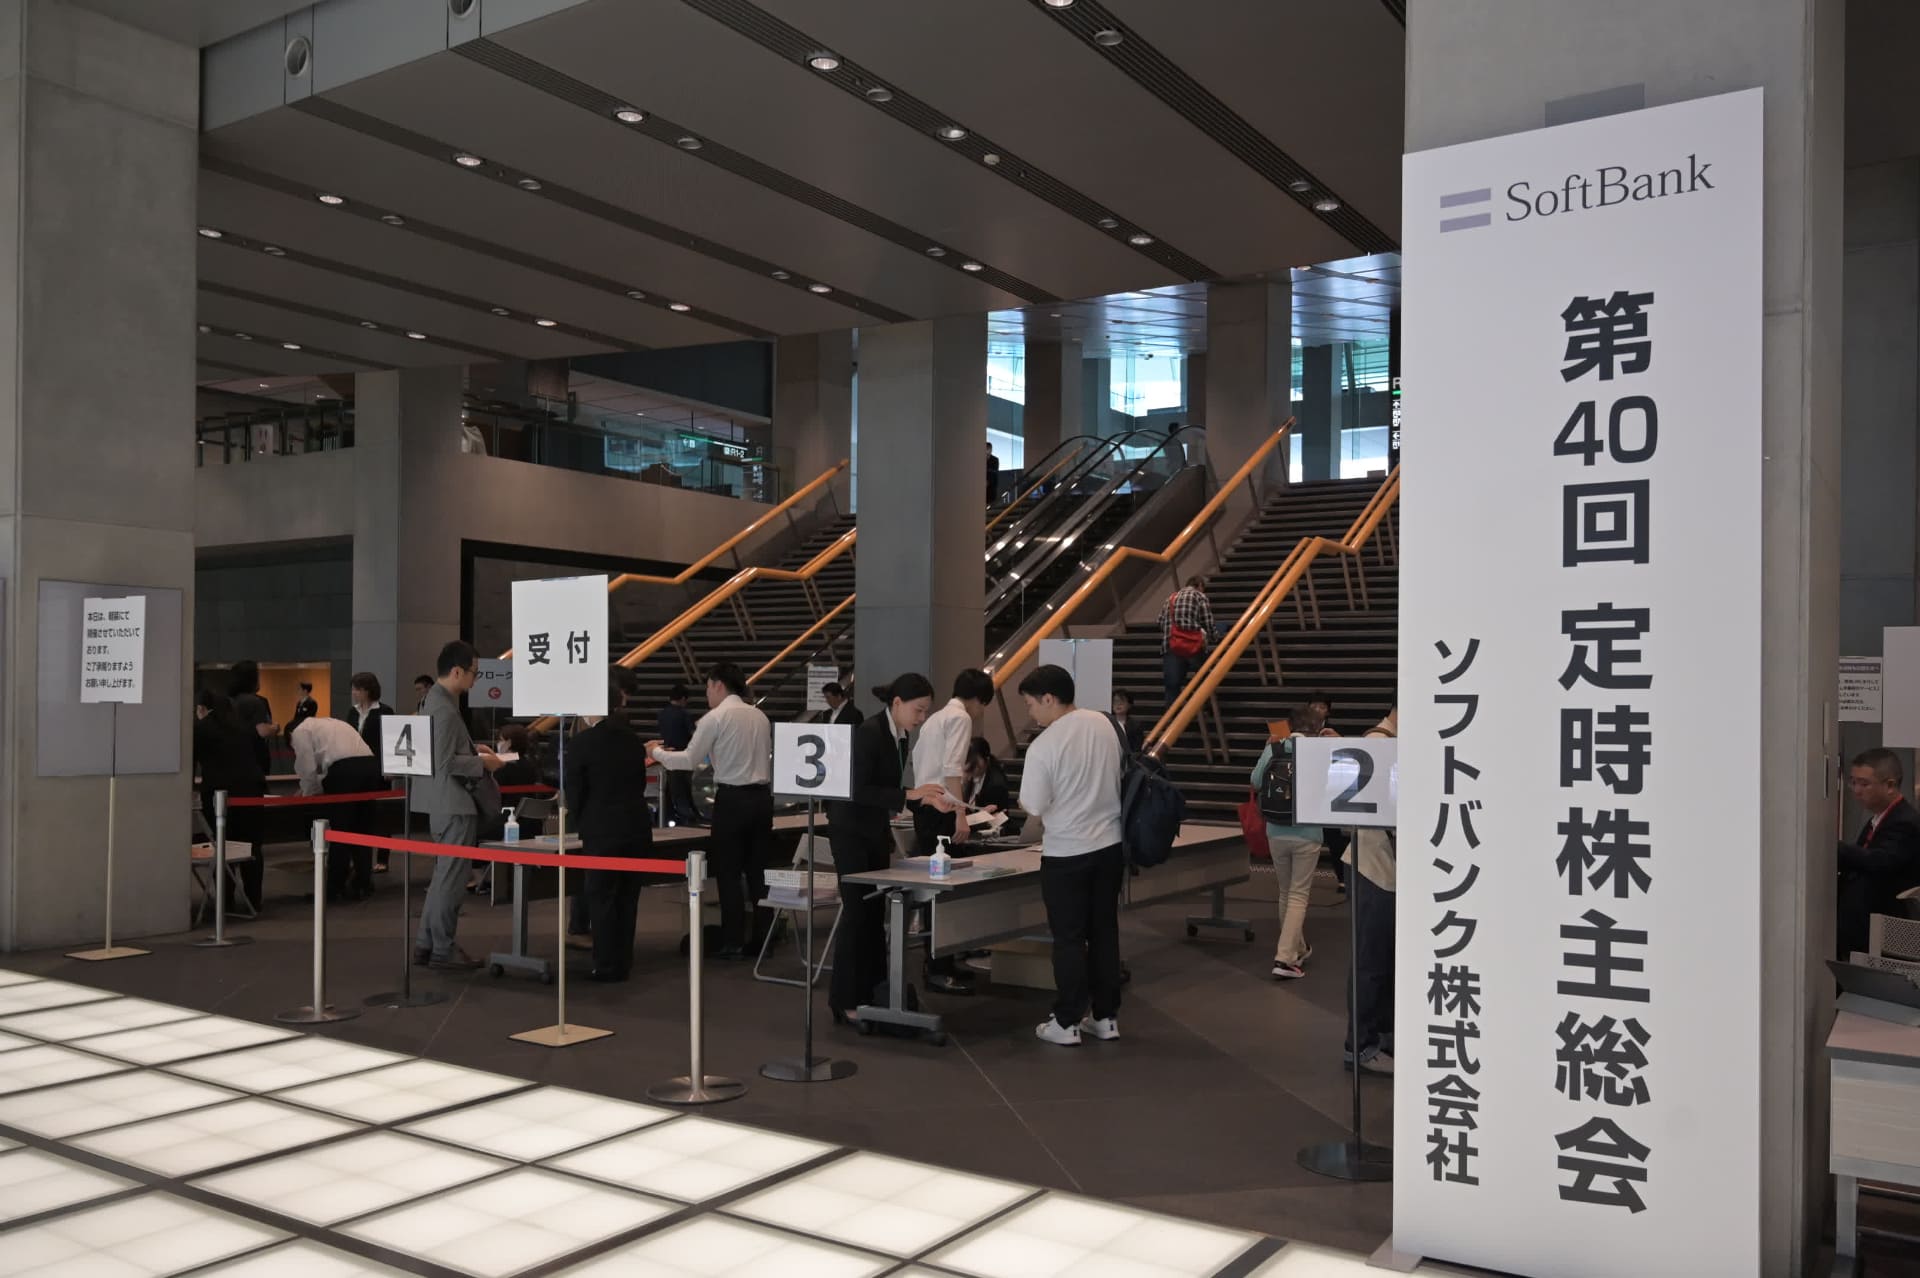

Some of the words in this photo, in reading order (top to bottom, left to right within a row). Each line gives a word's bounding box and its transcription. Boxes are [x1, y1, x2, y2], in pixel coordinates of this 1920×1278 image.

[1505, 153, 1716, 222] SoftBank
[528, 630, 591, 666] 受付
[394, 723, 416, 768] 4
[795, 734, 827, 789] 3
[1330, 747, 1378, 814] 2
[1425, 638, 1483, 1187] ソフトバンク株式会社
